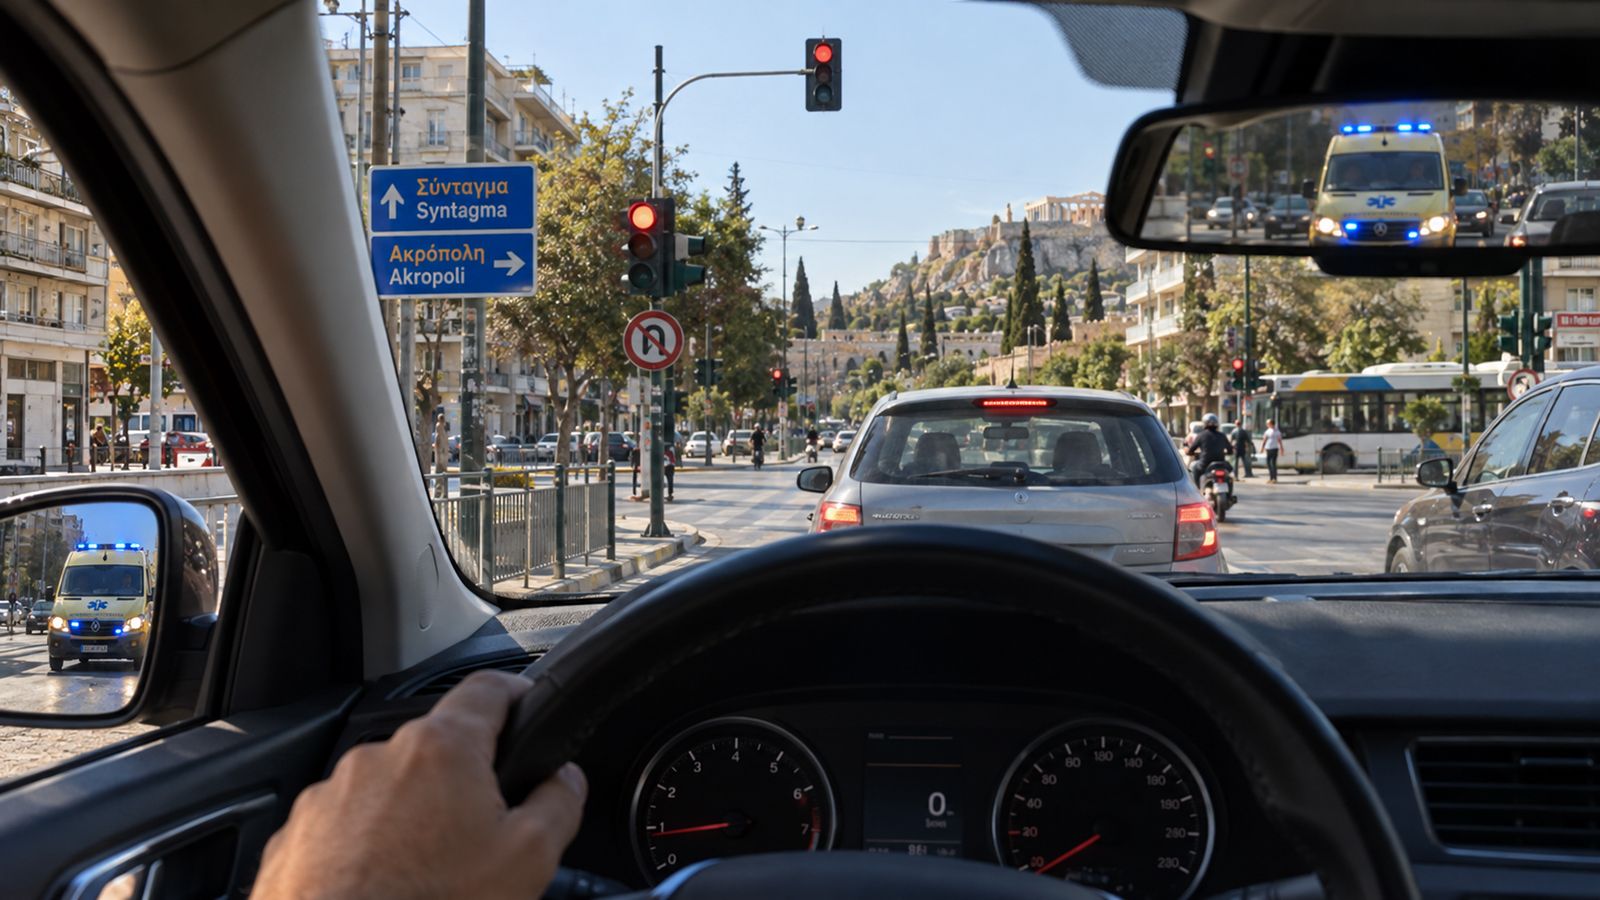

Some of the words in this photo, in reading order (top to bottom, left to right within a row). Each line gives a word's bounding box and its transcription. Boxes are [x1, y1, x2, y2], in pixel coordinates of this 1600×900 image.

[416, 177, 509, 199] Σύνταγμα
[416, 201, 508, 224] Syntagma
[389, 243, 485, 267] Ακρόπολη
[389, 267, 466, 289] Akropoli
[731, 751, 740, 762] 4
[693, 762, 702, 773] 3
[770, 762, 778, 773] 5
[667, 787, 676, 798] 2
[793, 788, 802, 799] 6
[928, 792, 946, 817] 0
[660, 822, 665, 832] 1
[801, 823, 809, 834] 7
[667, 854, 677, 864] 0
